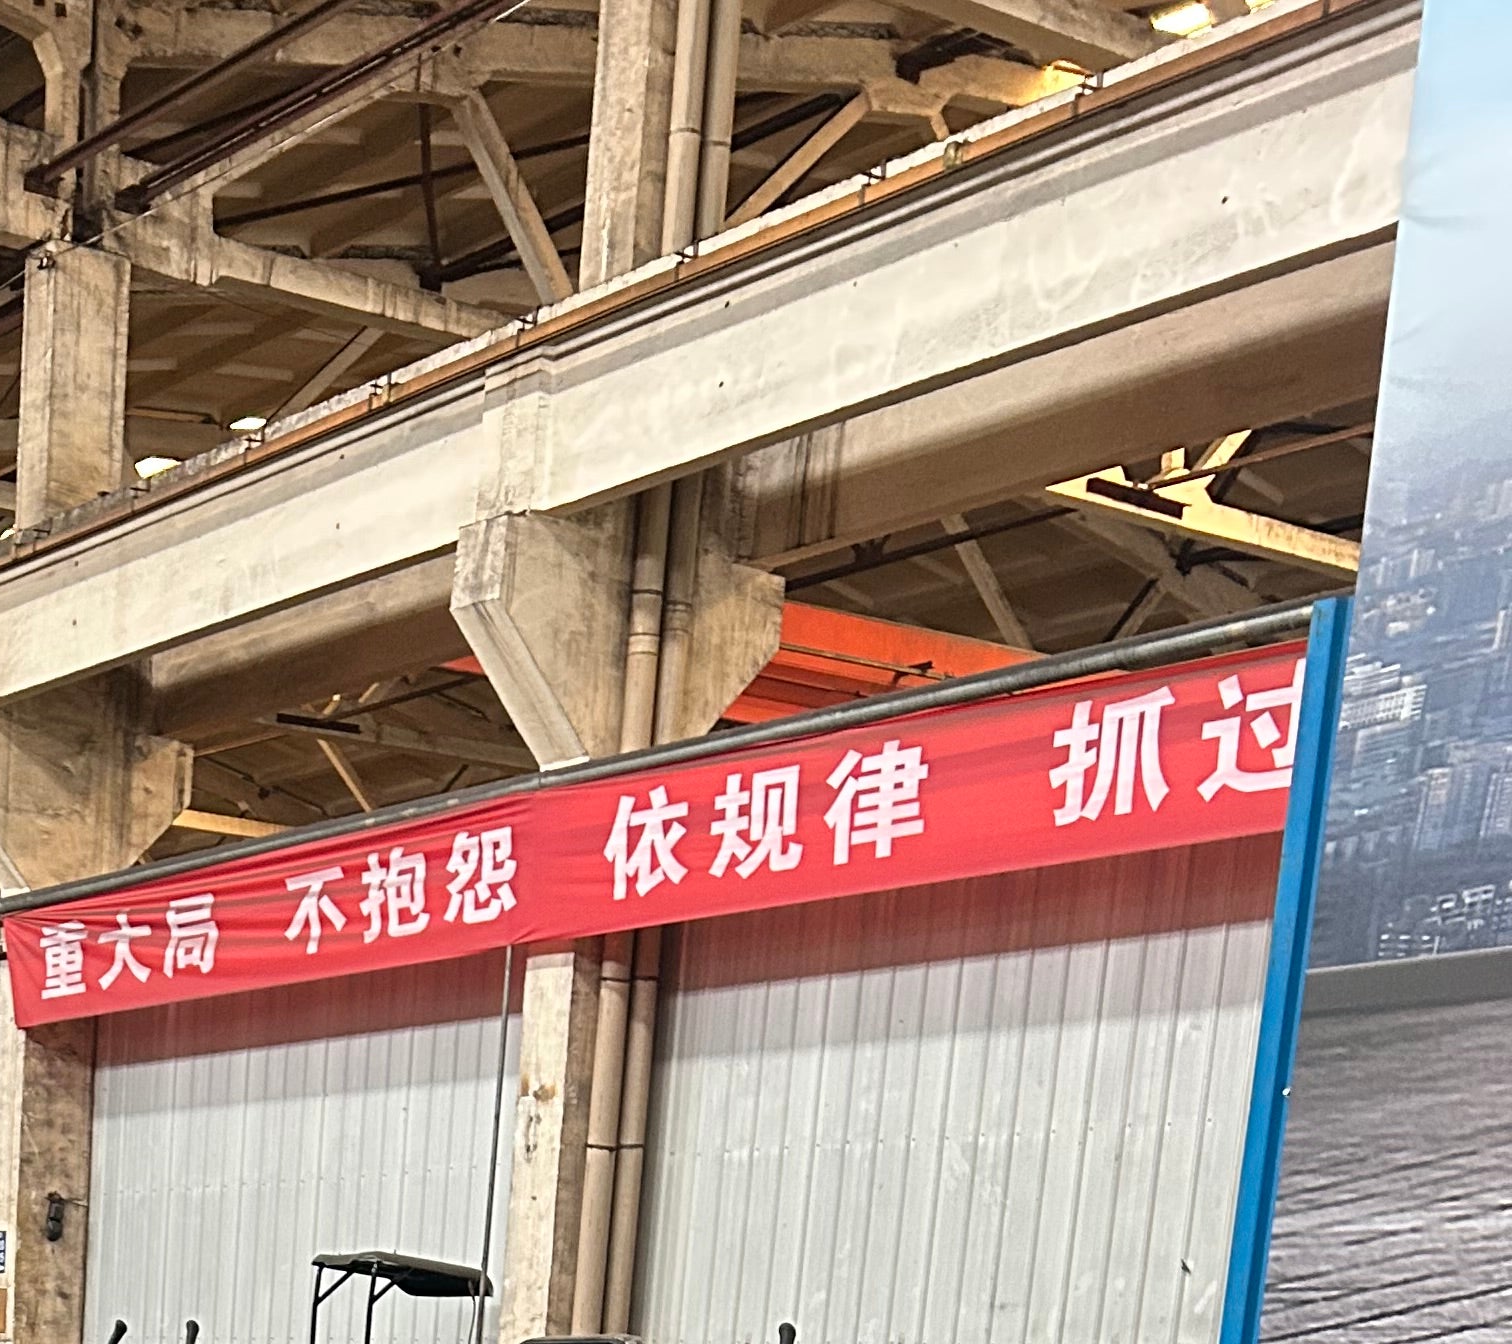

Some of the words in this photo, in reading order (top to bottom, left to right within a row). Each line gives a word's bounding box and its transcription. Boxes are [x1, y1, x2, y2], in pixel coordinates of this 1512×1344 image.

[39, 892, 220, 1000] 重大局
[283, 826, 518, 955] 不抱怨
[603, 738, 930, 901] 依规律
[1048, 657, 1307, 828] 抓过
